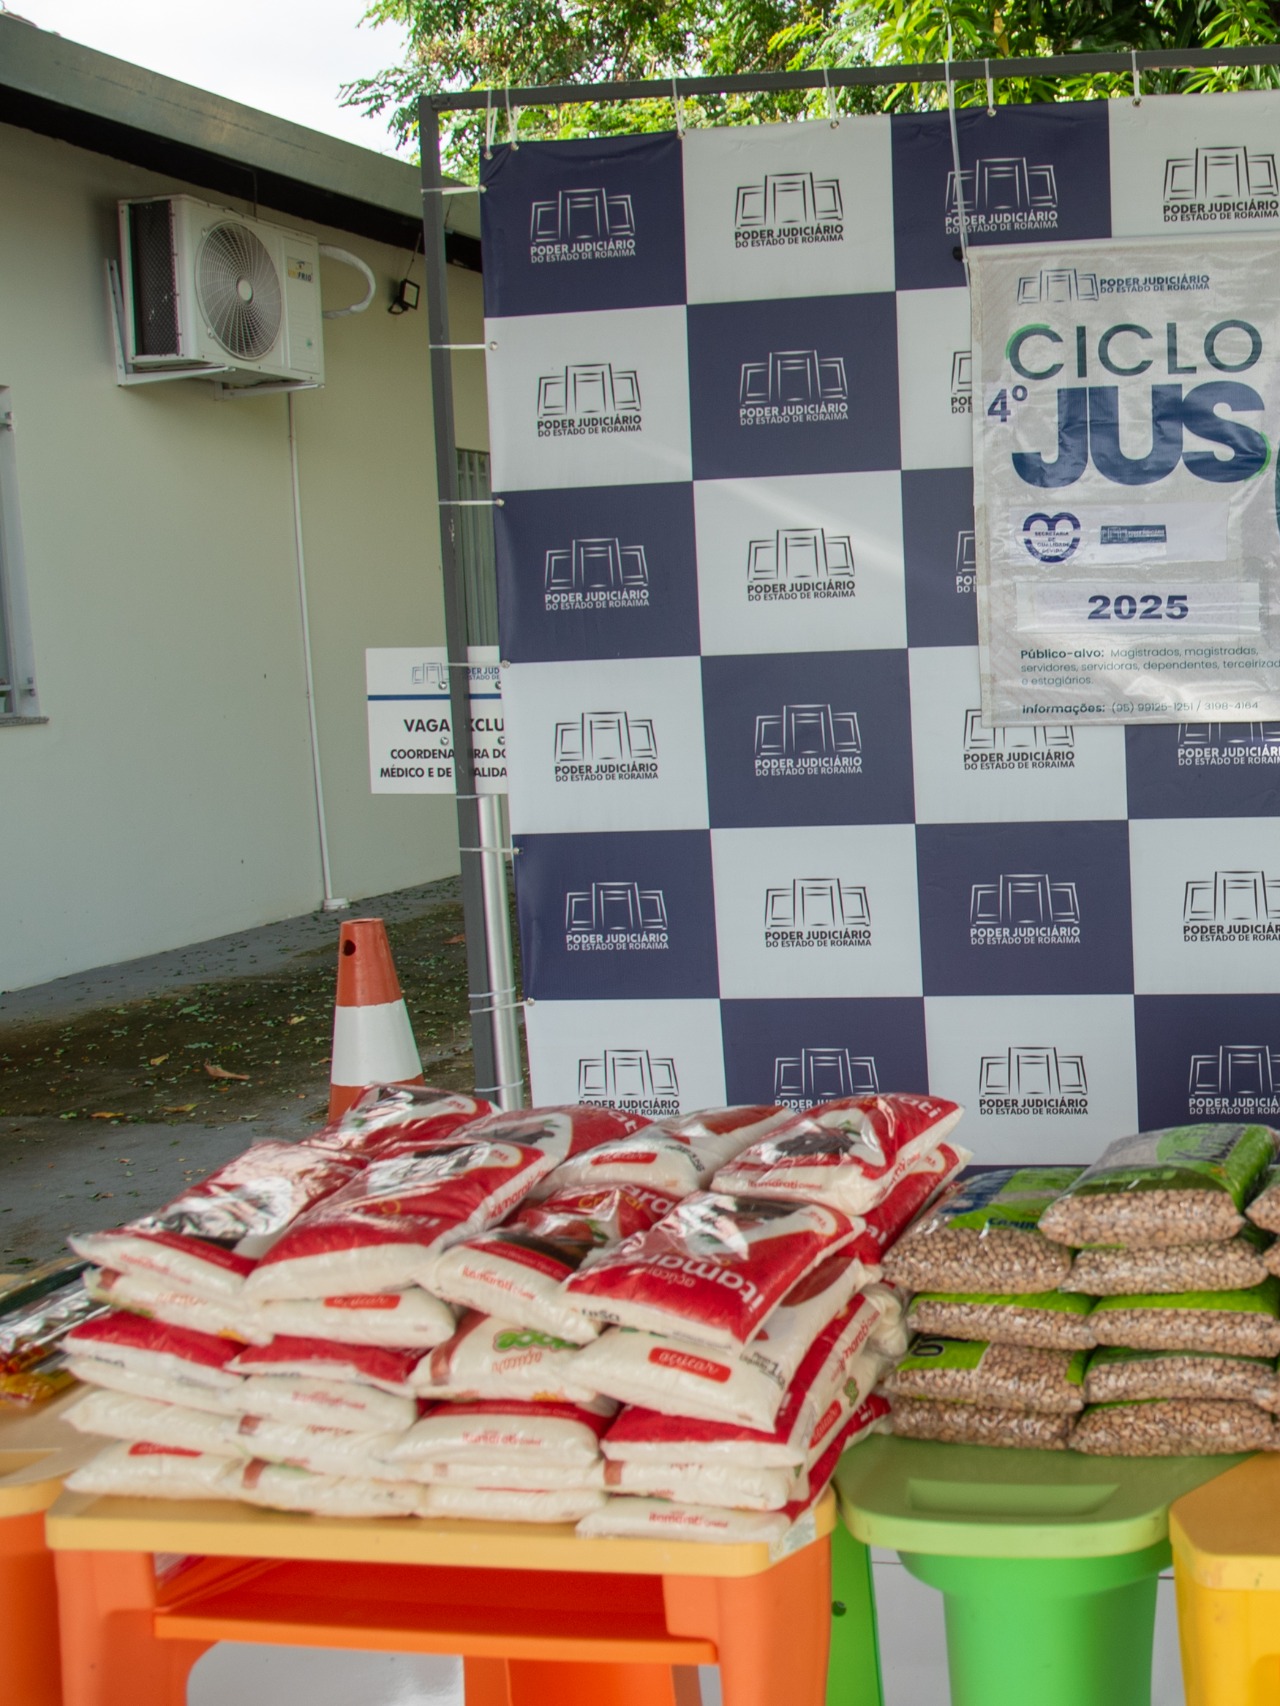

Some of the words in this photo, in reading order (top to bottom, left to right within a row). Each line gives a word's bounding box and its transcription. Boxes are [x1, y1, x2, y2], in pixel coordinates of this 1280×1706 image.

[1163, 203, 1205, 215] PODER
[1208, 198, 1279, 213] JUDICIÁRIO
[1163, 214, 1178, 223] DO
[1180, 213, 1217, 222] ESTADO
[1219, 212, 1231, 220] DE
[1234, 210, 1279, 219] RORAIMA
[530, 244, 569, 256] PODER
[571, 238, 636, 253] JUDICIÁRIO
[531, 255, 544, 264] DO
[546, 253, 579, 262] ESTADO
[581, 252, 593, 260] DE
[595, 249, 636, 259] RORAIMA
[1100, 278, 1140, 287] PODER
[1143, 274, 1210, 286] JUDICIÁRIO
[1100, 286, 1114, 294] DO
[1116, 284, 1151, 293] ESTADO
[1153, 284, 1165, 292] DE
[1167, 283, 1210, 291] RORAIMA
[1006, 319, 1263, 380] CICLO
[739, 406, 779, 418] PODER
[781, 401, 848, 416] JUDICIÁRIO
[740, 418, 754, 426] DO
[756, 416, 790, 425] ESTADO
[792, 415, 804, 423] DE
[806, 412, 848, 422] RORAIMA
[1011, 381, 1271, 487] JUS
[545, 592, 583, 603] PODER
[585, 588, 649, 602] JUDICIÁRIO
[545, 603, 559, 611] DO
[560, 602, 594, 610] ESTADO
[609, 599, 650, 608] RORAIMA
[1087, 595, 1189, 620] 2025
[1020, 648, 1104, 660] Público-alvo:
[1110, 647, 1182, 660] Magistrados,
[1184, 646, 1259, 658] magistradas,
[1021, 663, 1079, 673] servidores,
[1081, 661, 1140, 672] servidoras,
[1143, 660, 1220, 672] dependentes,
[1031, 675, 1094, 687] estagiários.
[404, 719, 451, 732] VAGA
[380, 765, 425, 778] MÉDICO
[428, 768, 434, 777] E
[438, 768, 452, 777] DE
[554, 765, 592, 775] PODER
[595, 760, 658, 774] JUDICIÁRIO
[570, 774, 603, 782] ESTADO
[605, 773, 616, 781] DE
[618, 772, 659, 780] RORAIMA
[765, 931, 804, 941] PODER
[806, 927, 871, 940] JUDICIÁRIO
[1183, 925, 1224, 935] PODER
[781, 940, 815, 948] ESTADO
[830, 939, 872, 947] RORAIMA
[1200, 934, 1236, 942] ESTADO
[1238, 934, 1250, 942] DE
